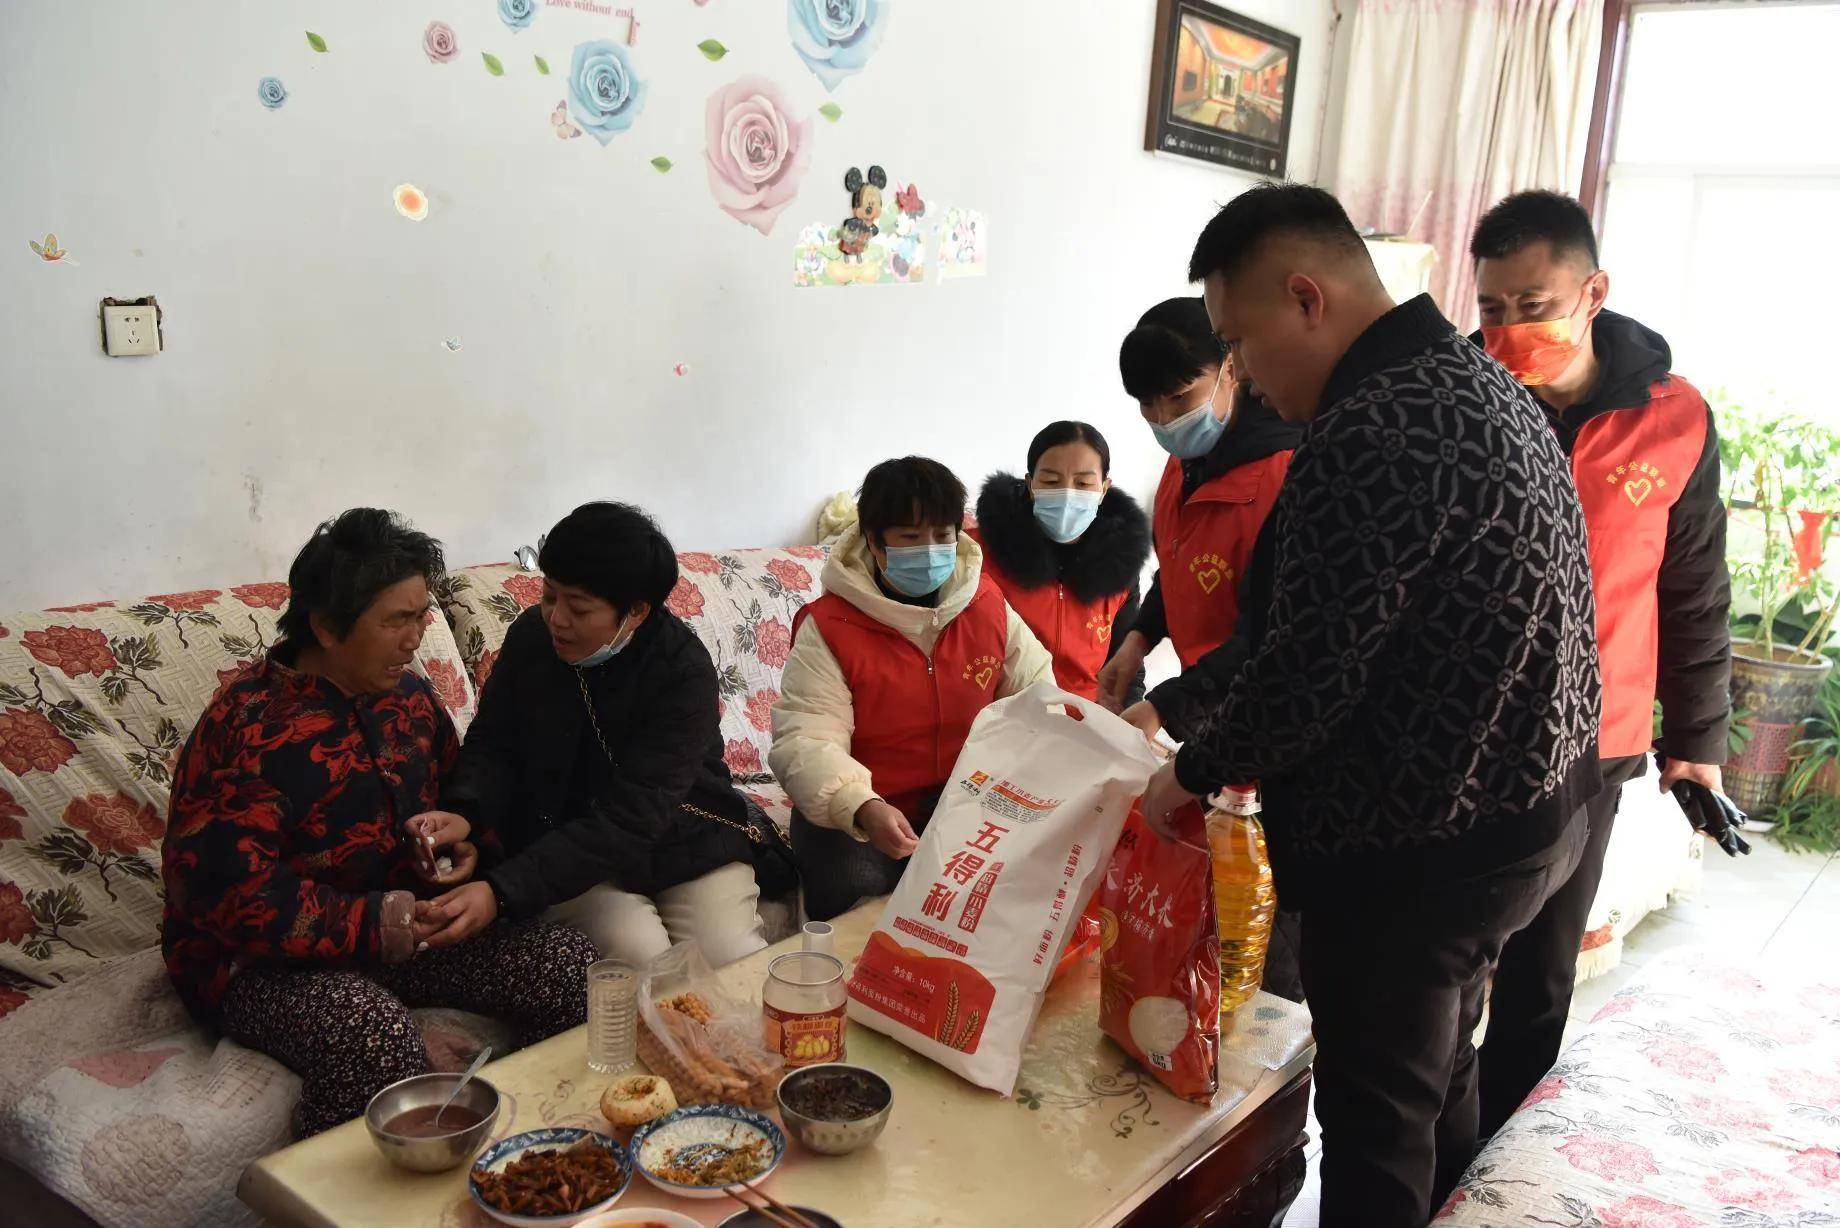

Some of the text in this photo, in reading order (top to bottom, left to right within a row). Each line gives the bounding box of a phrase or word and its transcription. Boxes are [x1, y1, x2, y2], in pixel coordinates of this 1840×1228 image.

[574, 1, 612, 15] without
[615, 8, 634, 17] end
[921, 820, 1010, 922] 五得利
